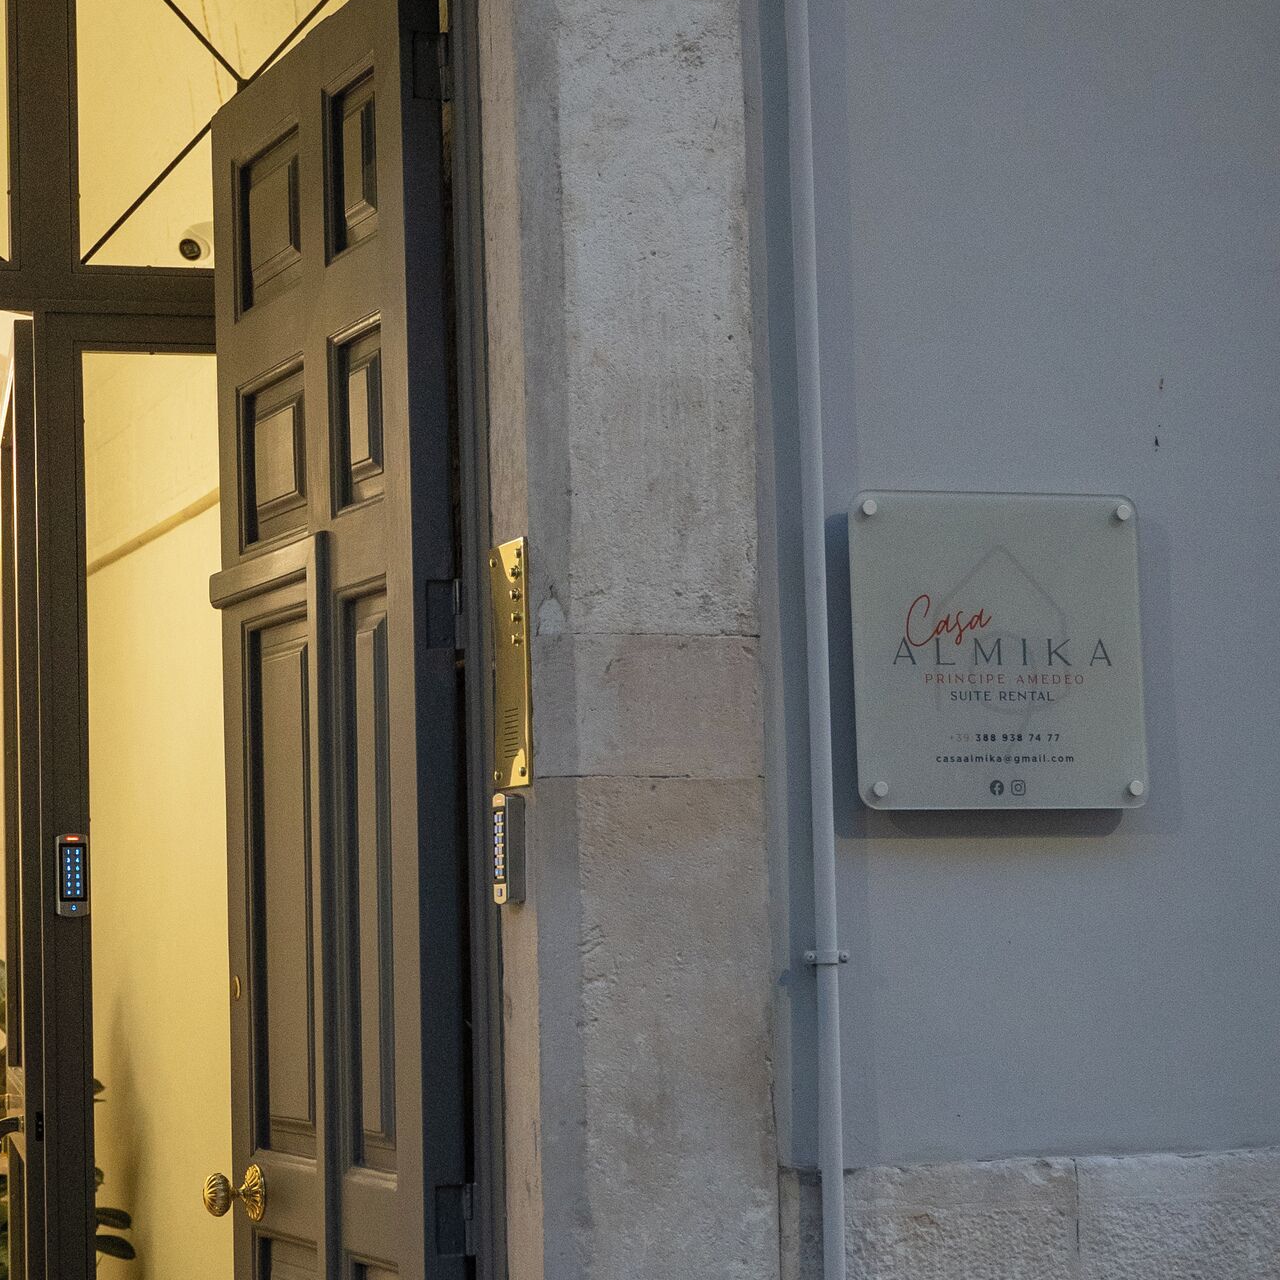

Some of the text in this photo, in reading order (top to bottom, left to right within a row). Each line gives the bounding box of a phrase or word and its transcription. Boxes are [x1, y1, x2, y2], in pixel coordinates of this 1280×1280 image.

[906, 594, 993, 647] Casa
[892, 638, 1112, 666] ALMIKA
[925, 673, 1085, 686] PRINCIPE AMEDEO
[950, 690, 1055, 702] SUITE RENTAL
[975, 733, 997, 742] 388
[1002, 733, 1023, 742] 938
[1028, 733, 1042, 742] 74
[1047, 733, 1061, 742] 77
[936, 753, 1075, 764] casaalmika@gmail.com
